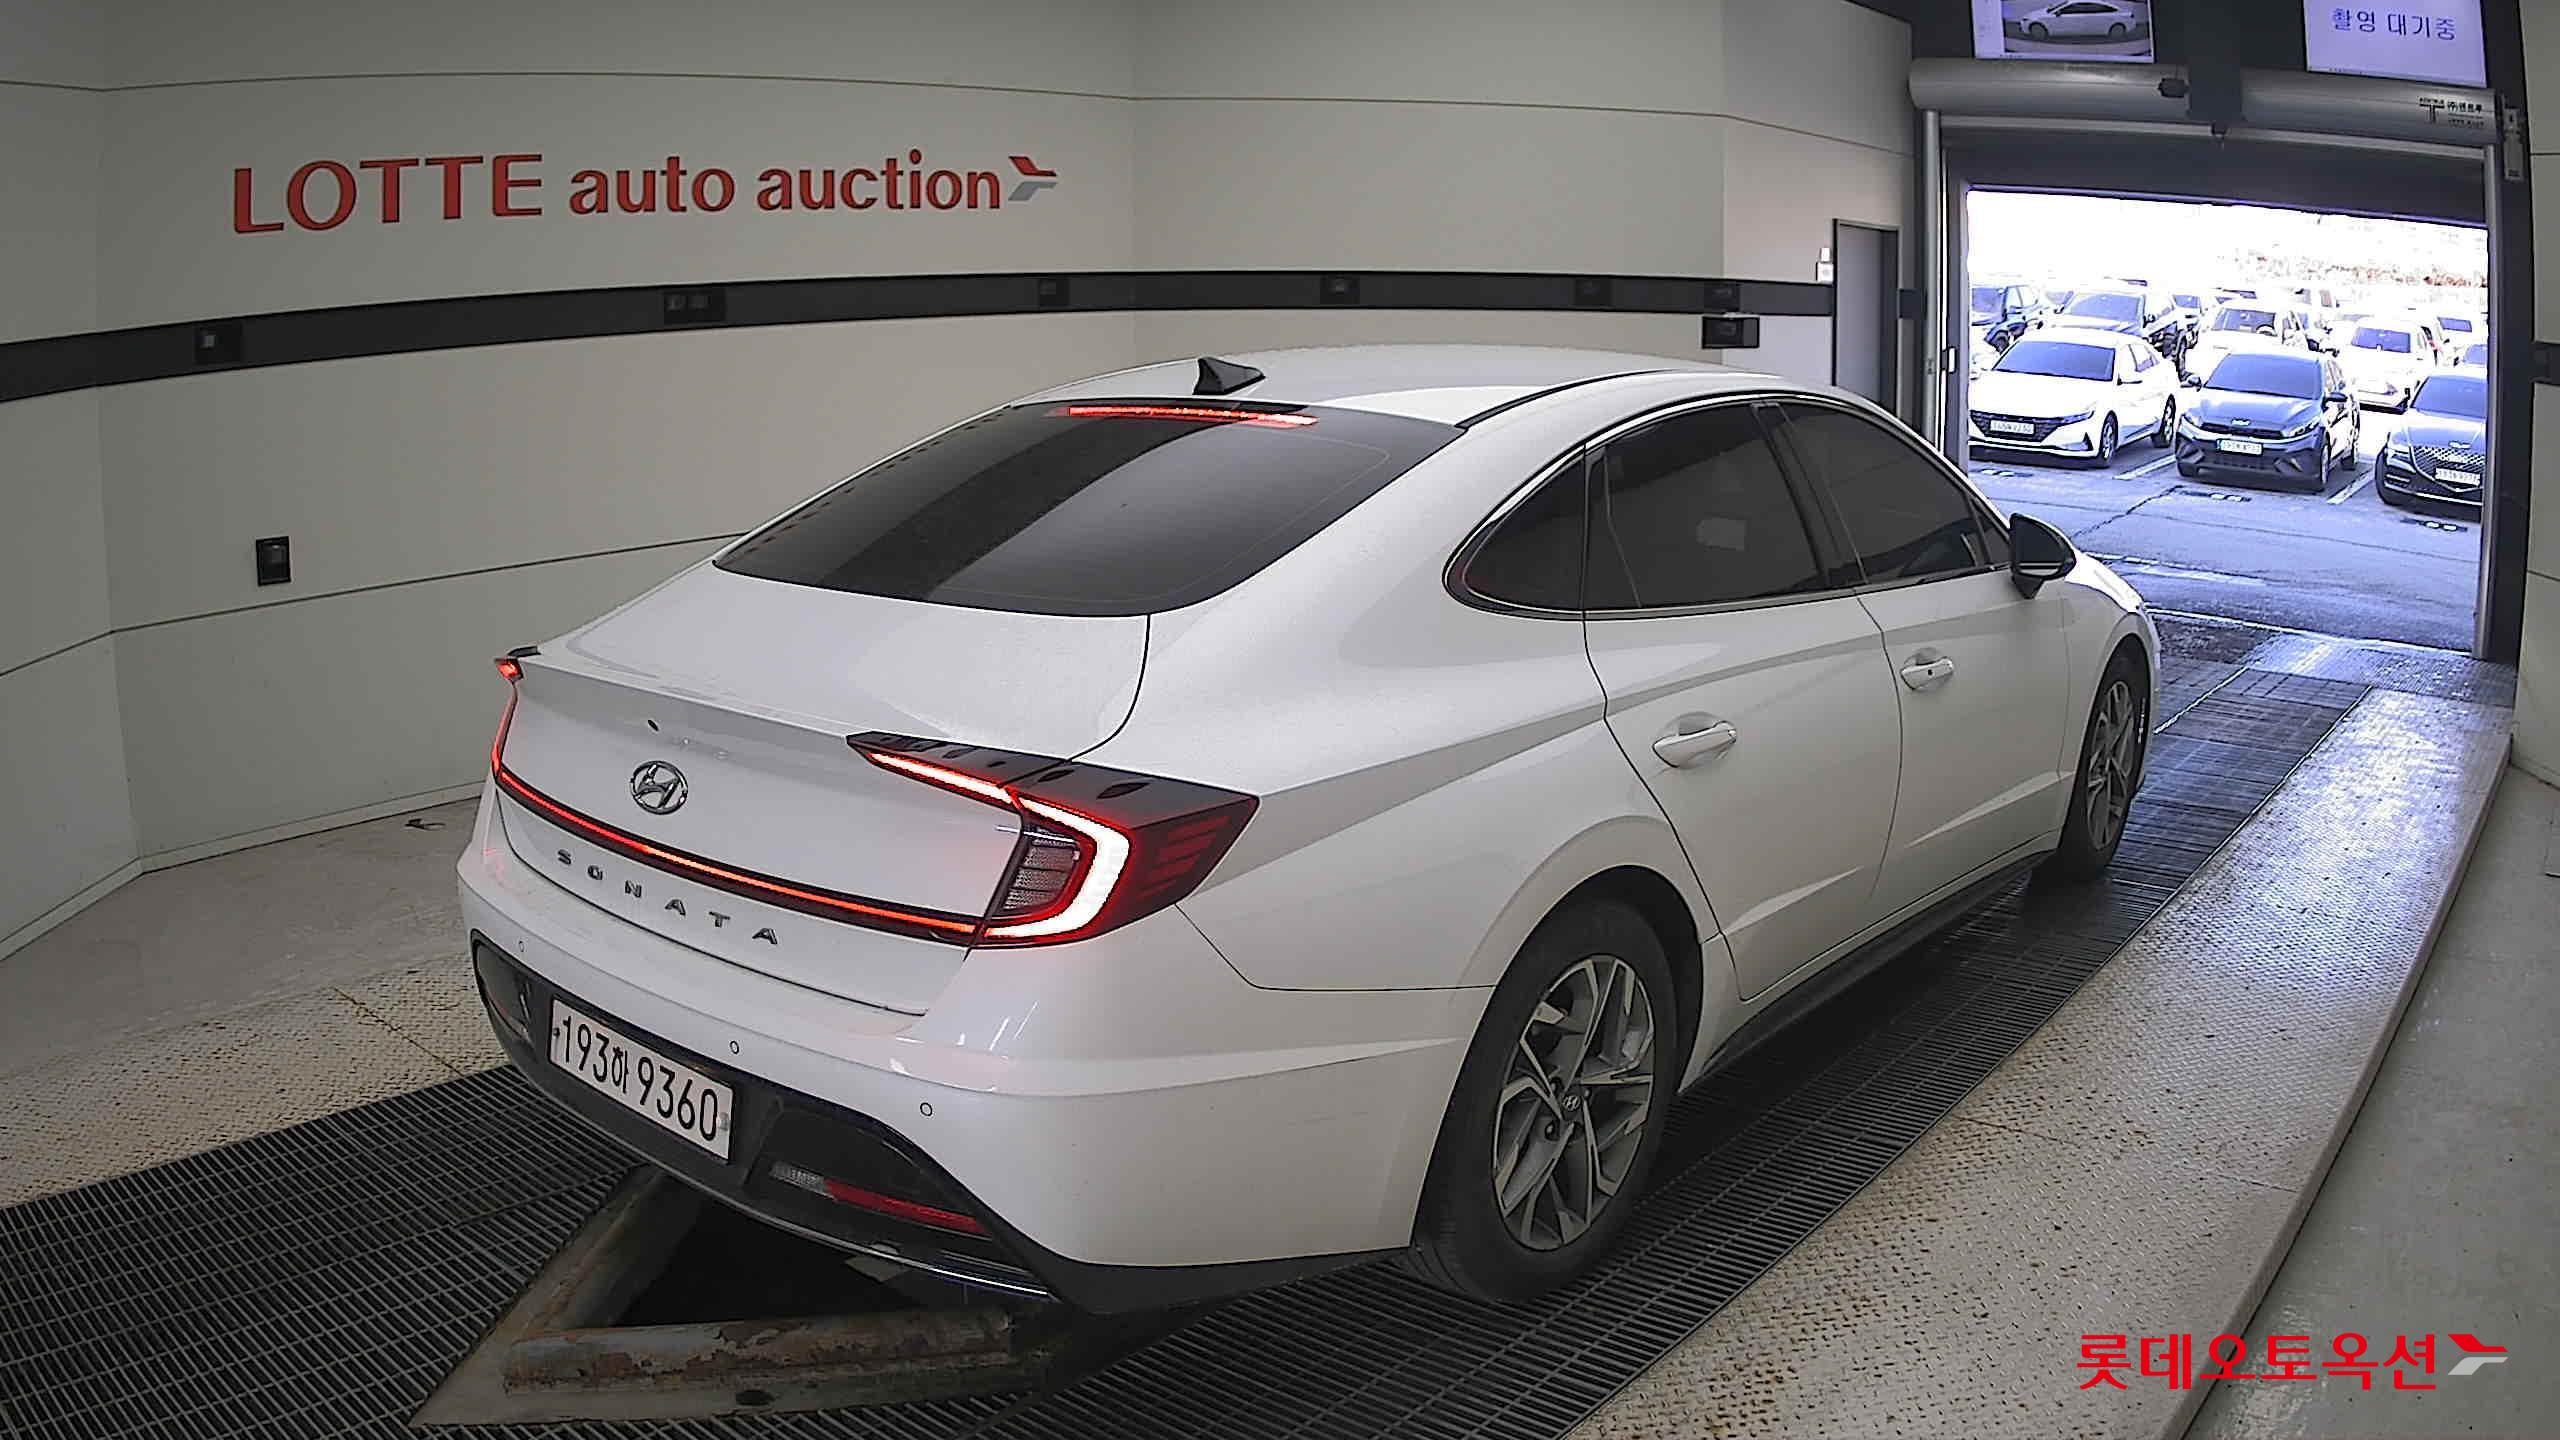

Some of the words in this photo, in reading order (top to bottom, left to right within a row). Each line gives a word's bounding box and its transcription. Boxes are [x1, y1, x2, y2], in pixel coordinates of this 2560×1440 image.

[2333, 8, 2376, 33] 촬영
[2387, 14, 2455, 41] 대기중
[233, 153, 543, 233] LOTTE
[568, 156, 736, 214] auto
[756, 149, 1001, 210] auction
[557, 848, 779, 945] SONATA
